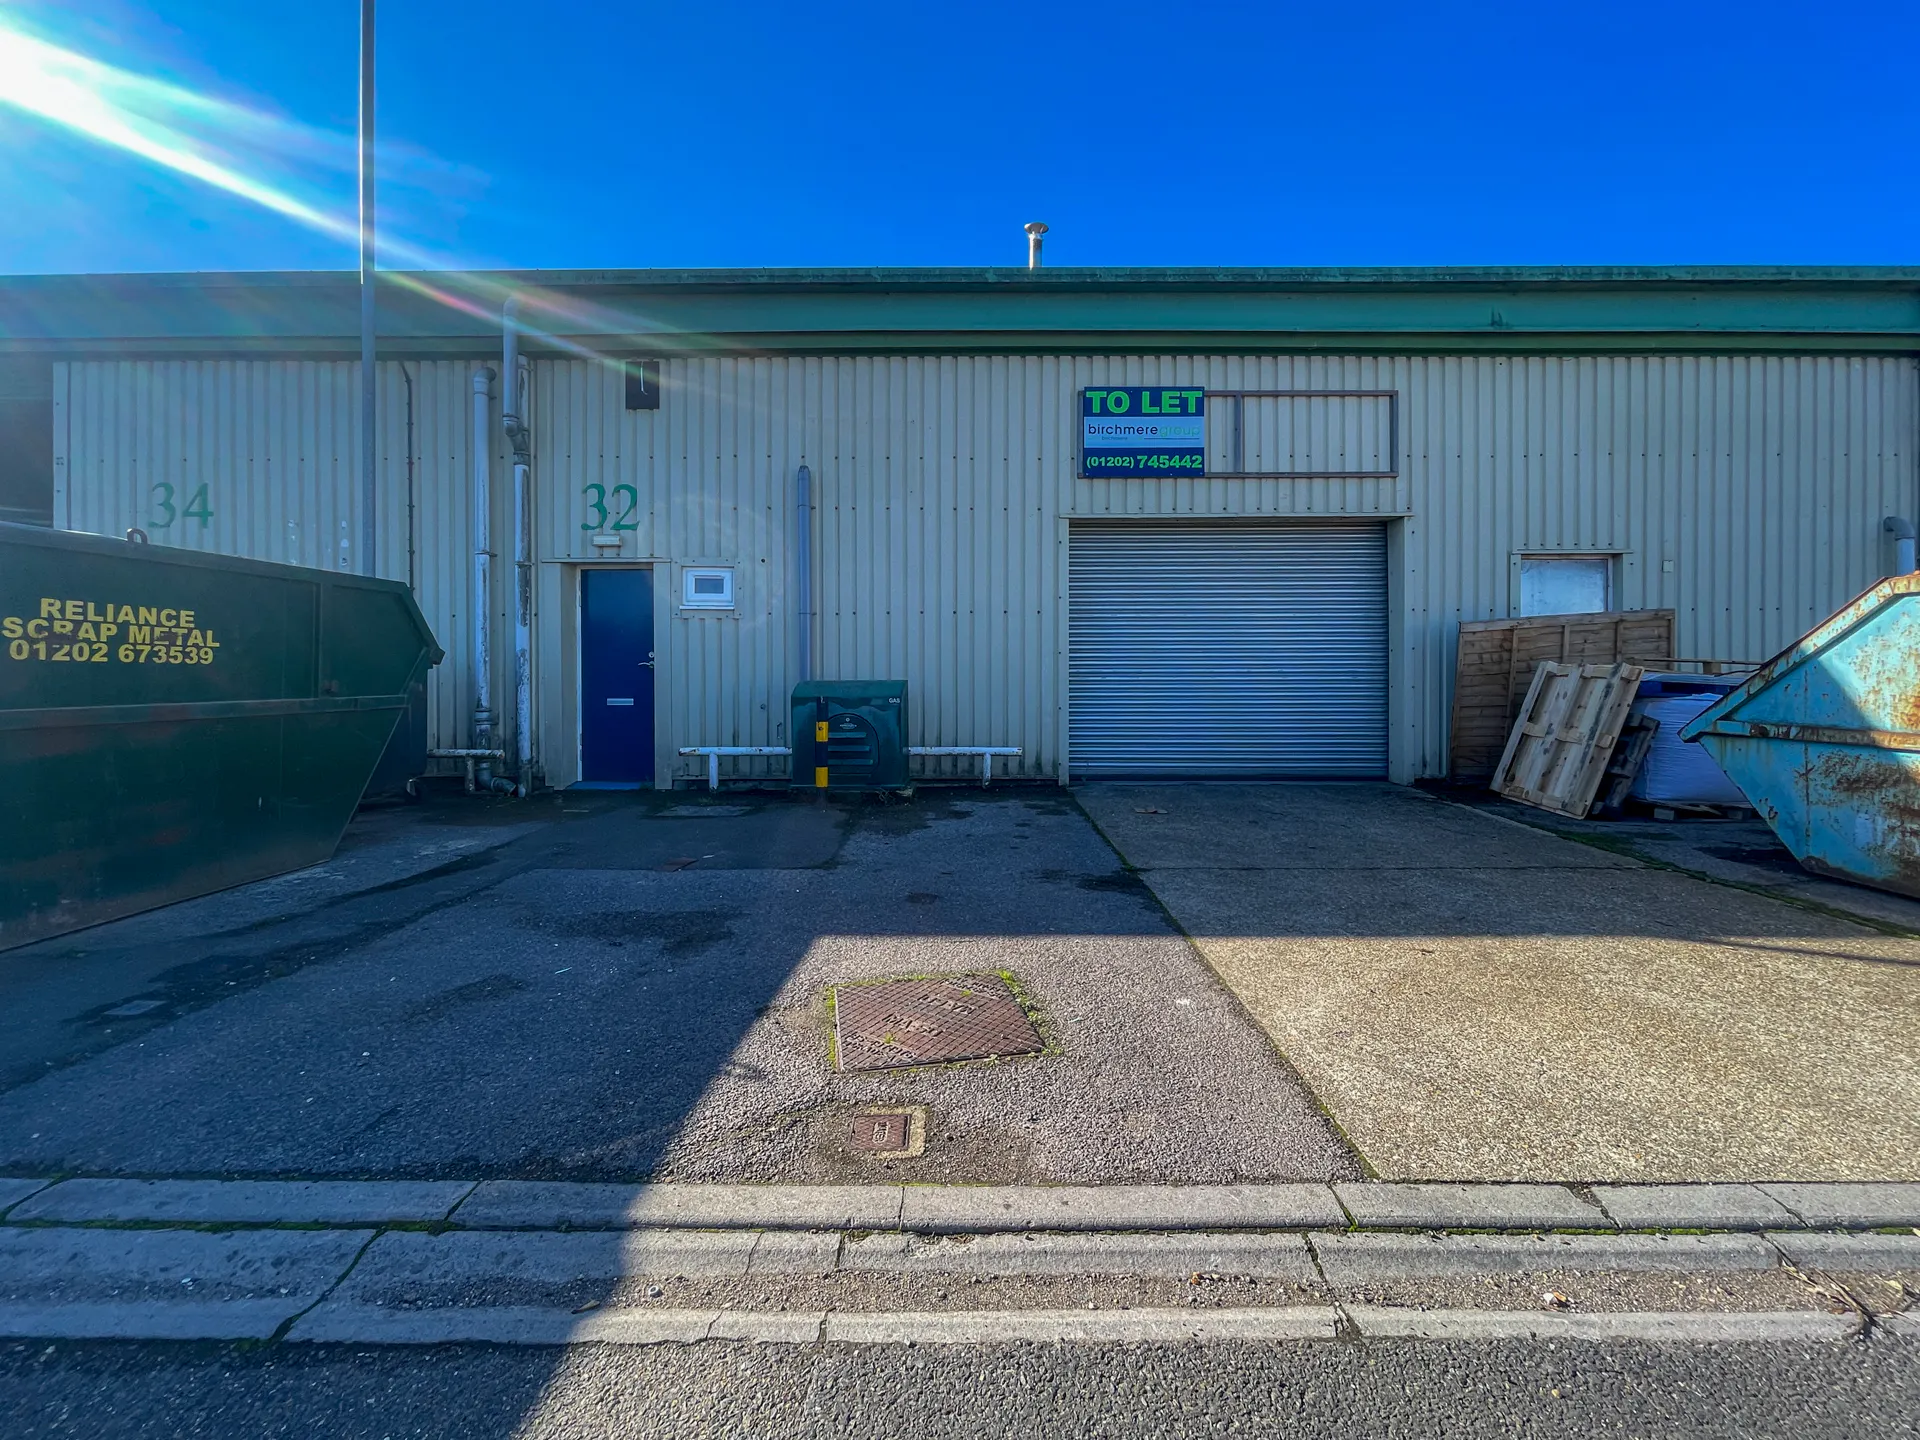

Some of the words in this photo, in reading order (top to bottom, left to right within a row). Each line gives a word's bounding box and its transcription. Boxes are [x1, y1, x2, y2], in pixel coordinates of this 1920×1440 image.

[1086, 391, 1130, 414] TO
[1141, 391, 1202, 413] LET
[1088, 424, 1158, 435] birchmere
[1160, 426, 1200, 437] group
[1086, 456, 1134, 469] (01202)
[1137, 455, 1203, 469] 745442
[148, 482, 214, 529] 34
[580, 483, 640, 531] 32
[40, 597, 195, 628] RELIANCE
[2, 617, 118, 642] SCRAP
[129, 625, 220, 647] METAL
[9, 639, 108, 662] 01202
[118, 644, 214, 665] 673539
